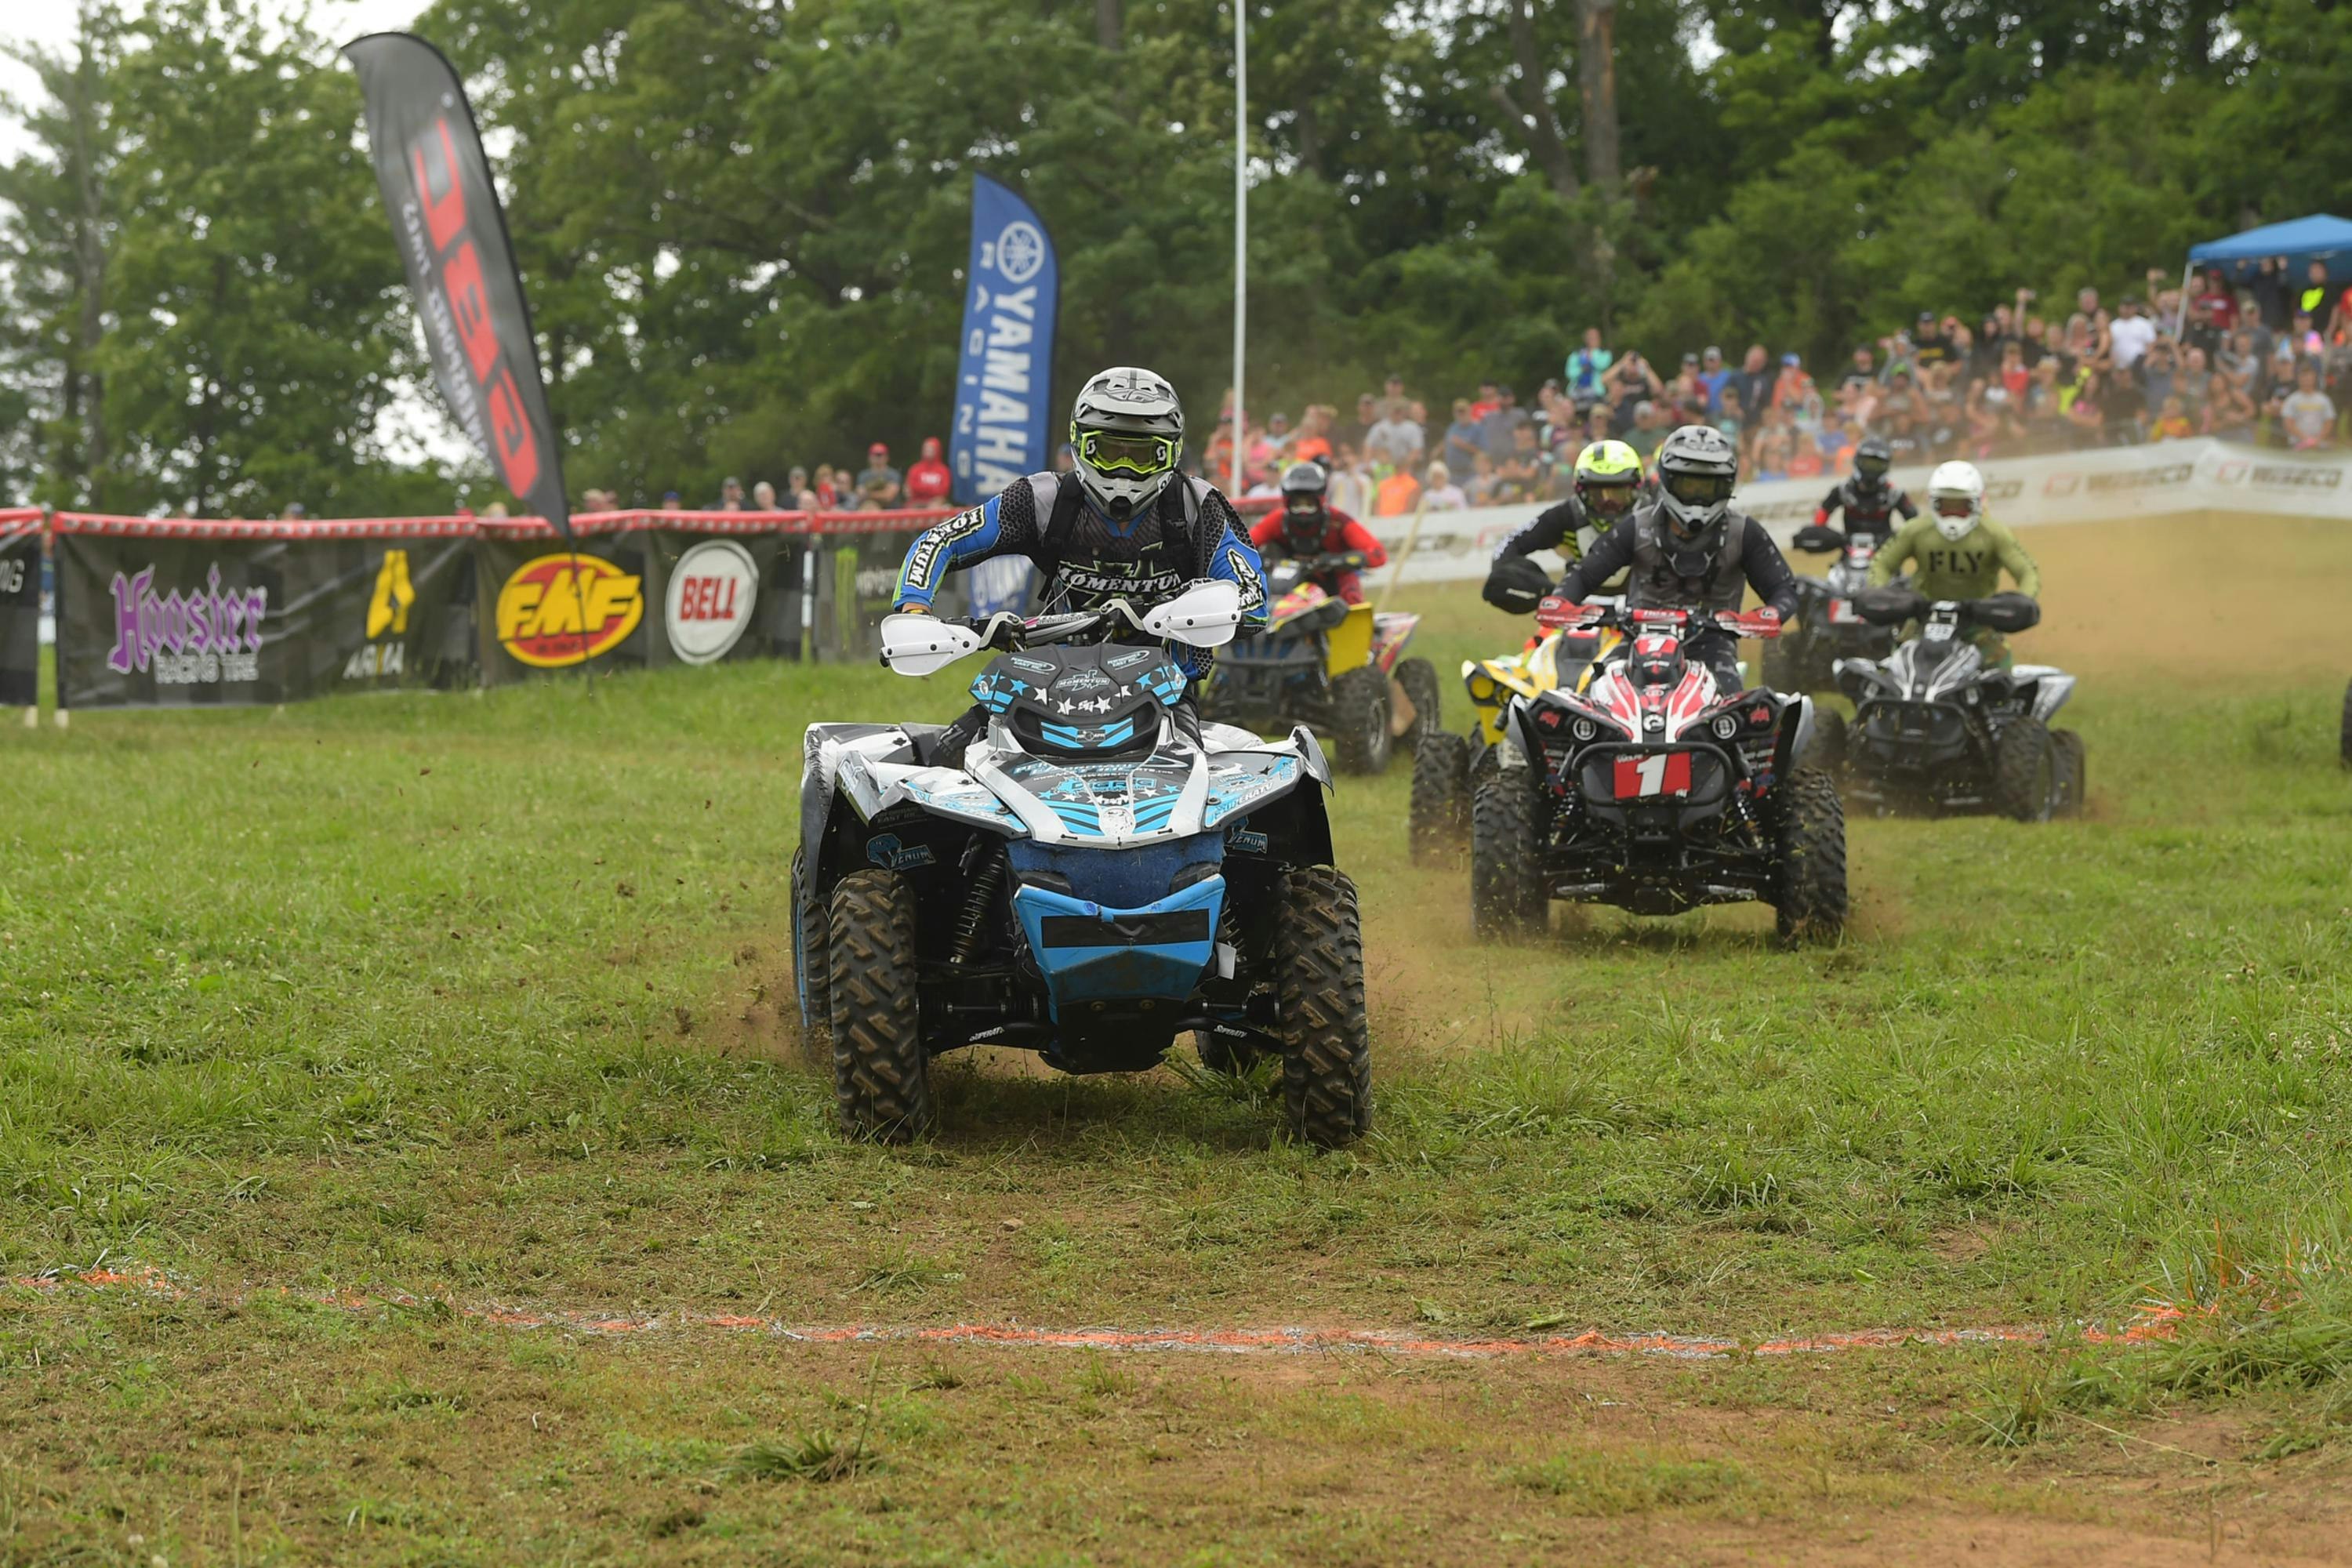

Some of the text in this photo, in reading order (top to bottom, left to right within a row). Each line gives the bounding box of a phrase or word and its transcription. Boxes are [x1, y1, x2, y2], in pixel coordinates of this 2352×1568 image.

[956, 241, 996, 478] RACING
[976, 285, 1038, 495] YAMAHA
[1929, 550, 1984, 572] FLY
[497, 567, 641, 641] FMF
[680, 576, 737, 620] BELL
[1635, 753, 1668, 797] 1
